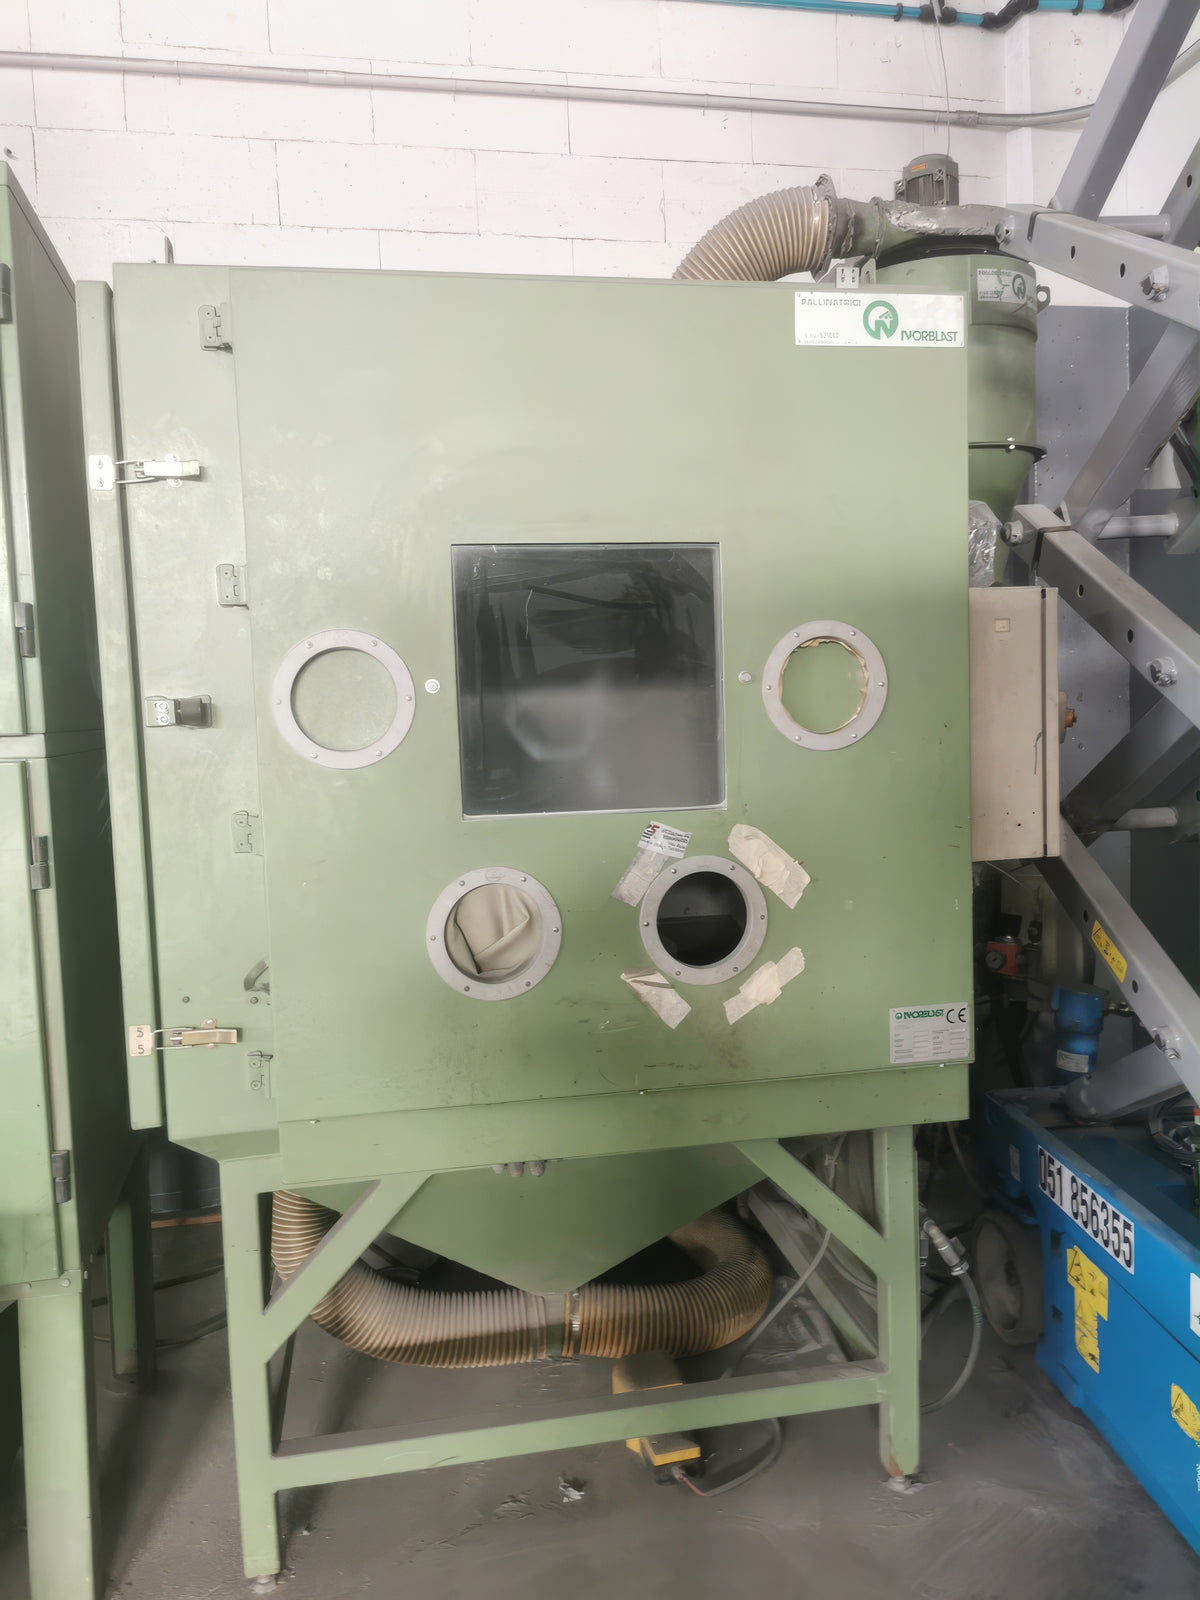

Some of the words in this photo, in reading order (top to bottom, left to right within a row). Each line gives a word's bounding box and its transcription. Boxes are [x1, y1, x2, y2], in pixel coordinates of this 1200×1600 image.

[900, 330, 958, 342] NORBLAST
[1038, 1146, 1064, 1207] 051
[1070, 1175, 1133, 1269] 856355
